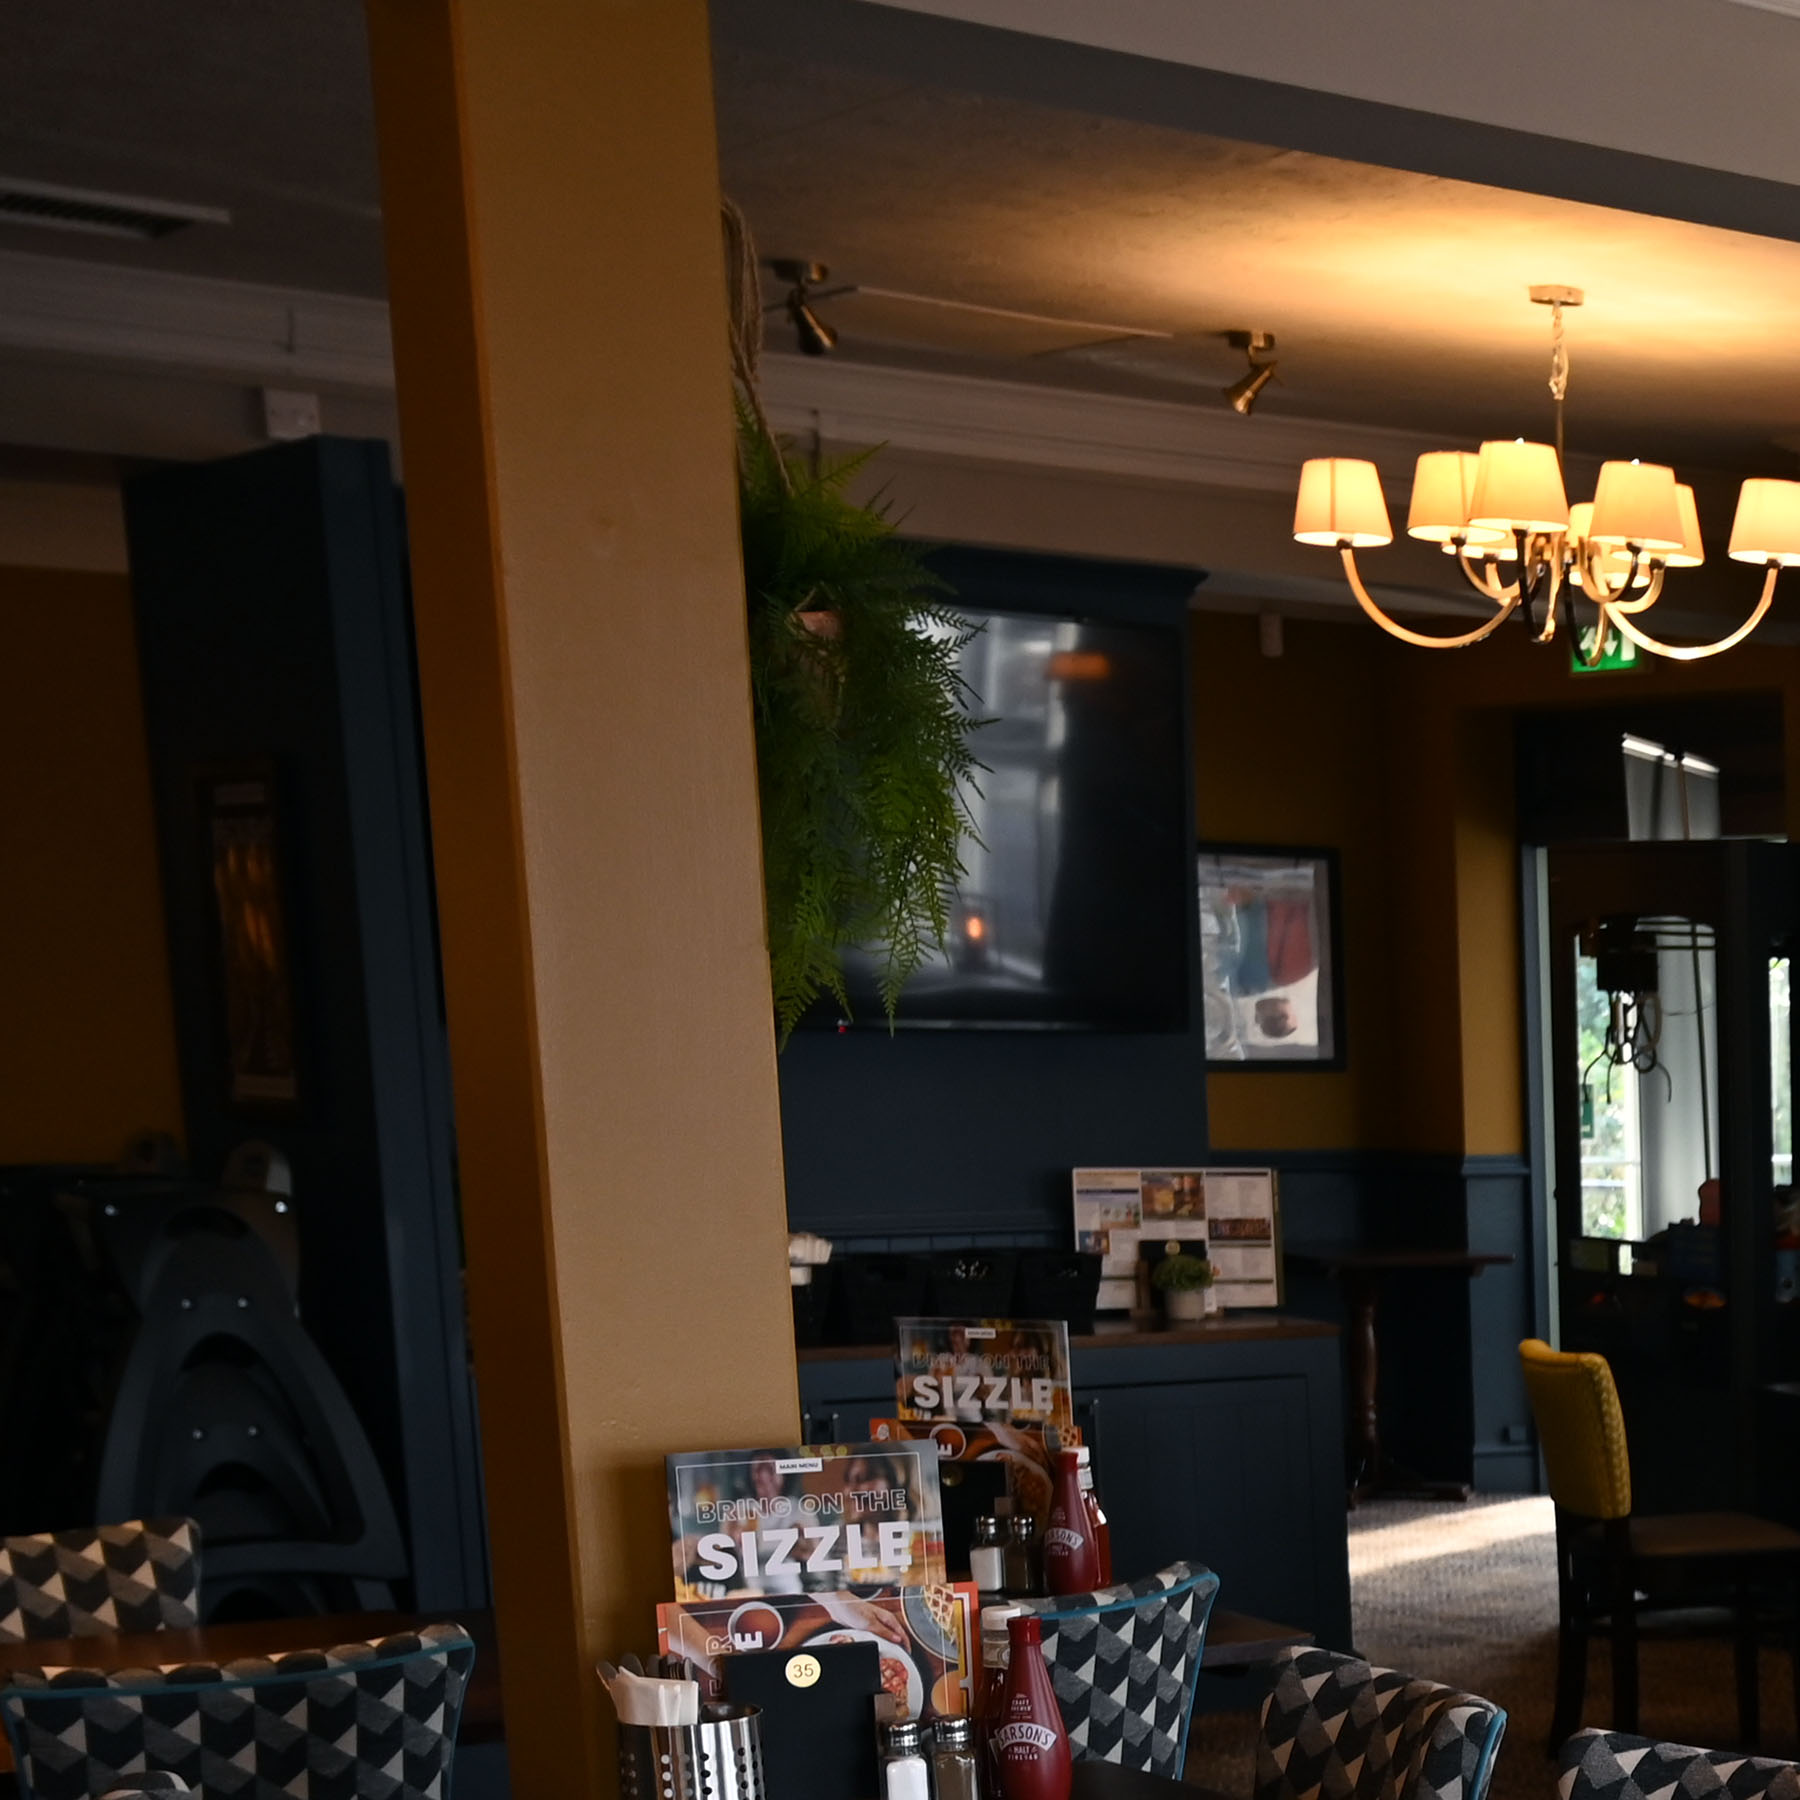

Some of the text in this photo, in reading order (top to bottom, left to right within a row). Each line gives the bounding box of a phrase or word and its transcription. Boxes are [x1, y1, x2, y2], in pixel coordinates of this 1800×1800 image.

[913, 1374, 1054, 1410] SIZZLE
[696, 1489, 907, 1523] BRING ON THE
[697, 1521, 912, 1581] SIZZLE
[793, 1663, 814, 1679] 35
